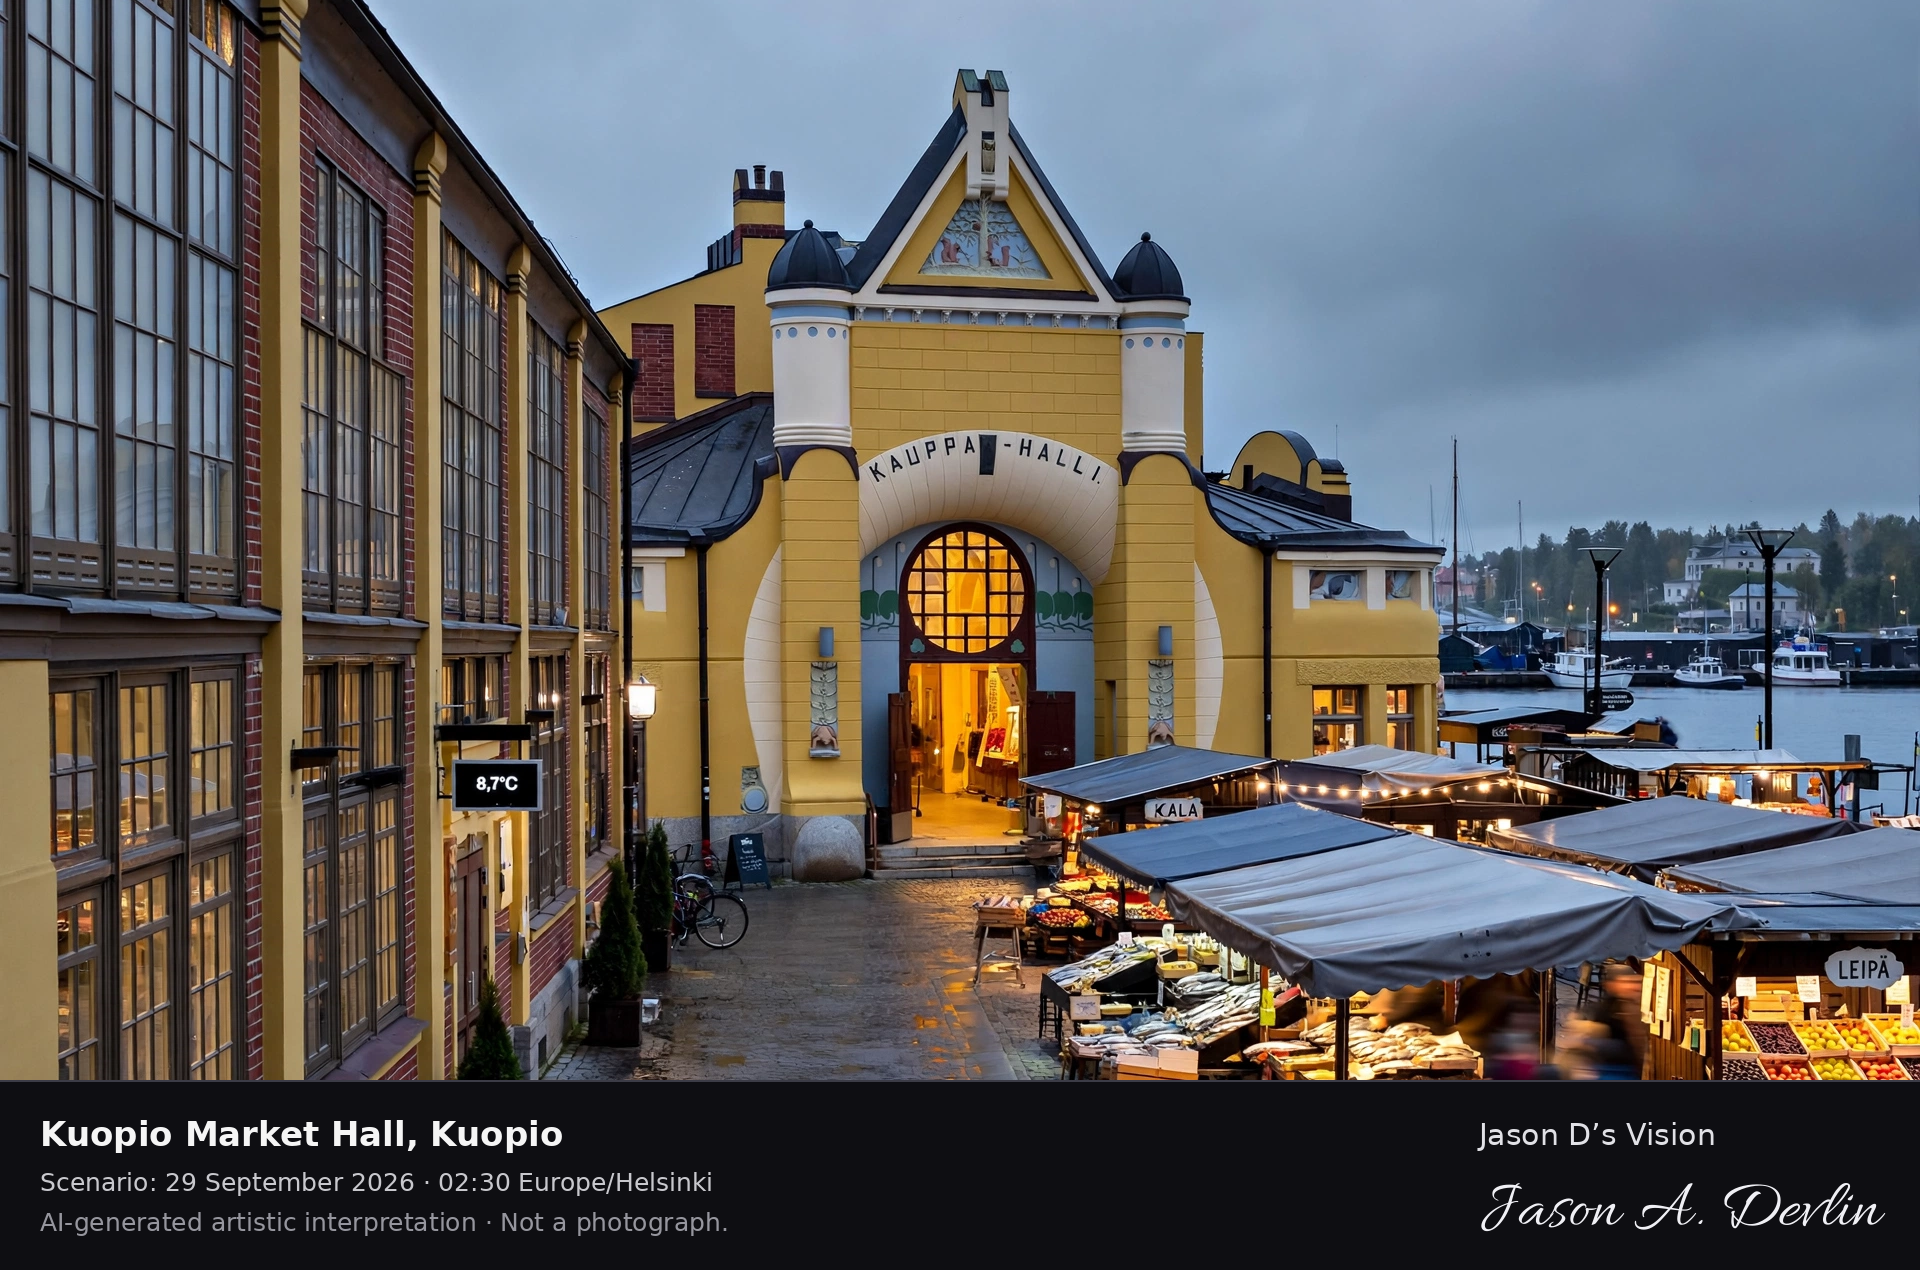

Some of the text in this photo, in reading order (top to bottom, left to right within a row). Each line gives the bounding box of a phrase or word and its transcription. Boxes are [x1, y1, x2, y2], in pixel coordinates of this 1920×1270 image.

[868, 436, 975, 482] KAUPPA
[476, 776, 518, 793] 8,7°C
[1154, 803, 1198, 818] KALA
[1838, 955, 1890, 980] LEIPÄ
